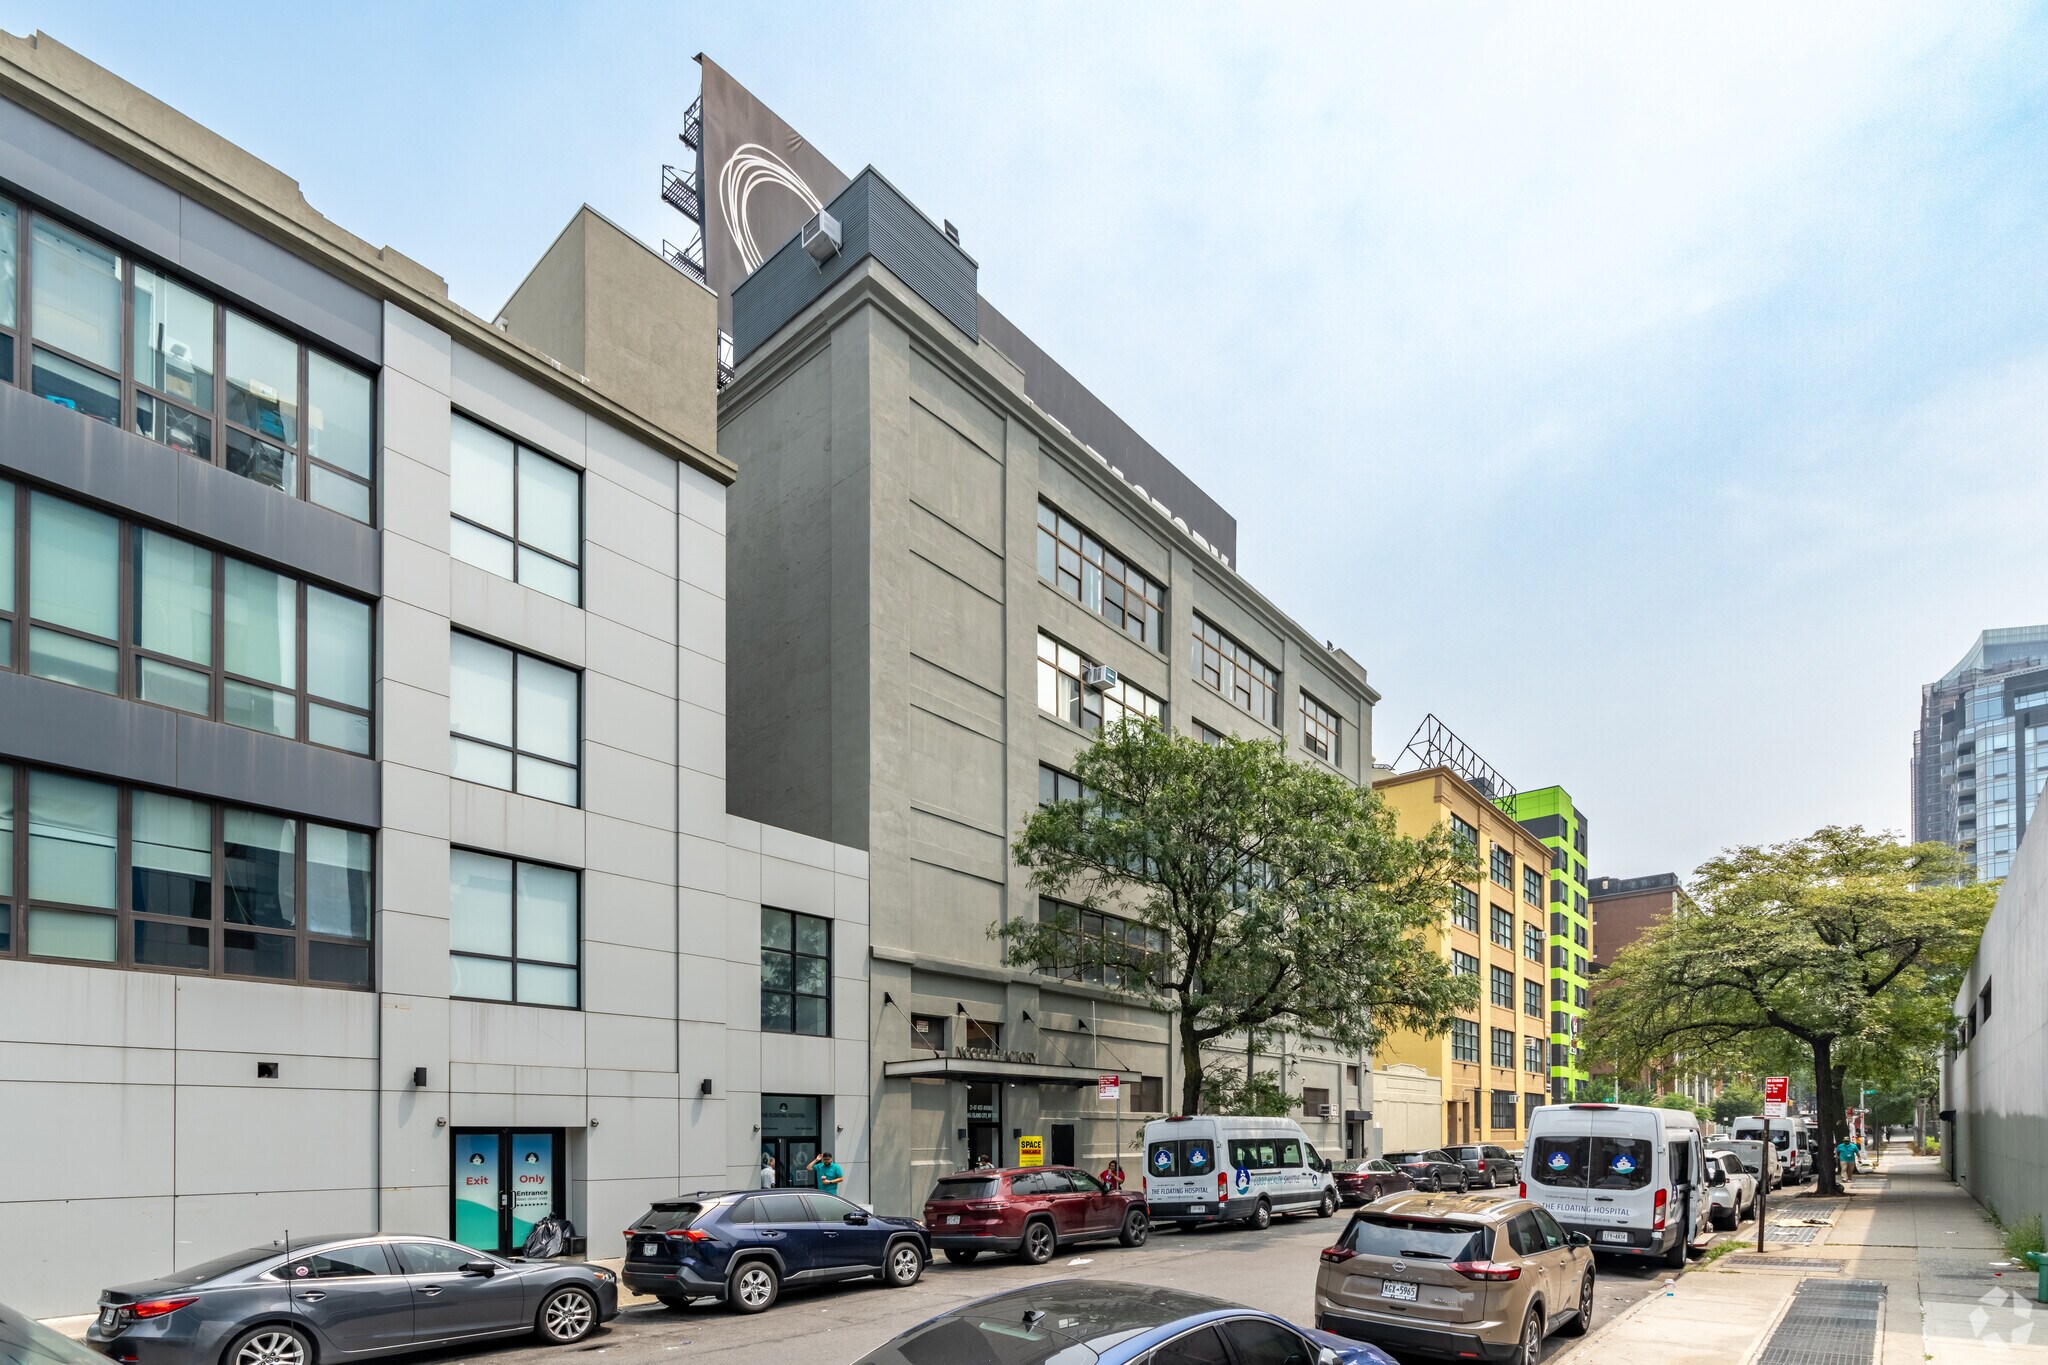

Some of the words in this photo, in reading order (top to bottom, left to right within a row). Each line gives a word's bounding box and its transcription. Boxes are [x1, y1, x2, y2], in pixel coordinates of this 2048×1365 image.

[466, 1176, 488, 1185] Exit
[519, 1174, 545, 1184] Only
[1542, 1202, 1555, 1210] THE
[1557, 1203, 1592, 1212] FLOATING
[1593, 1206, 1630, 1216] HOSPITAL
